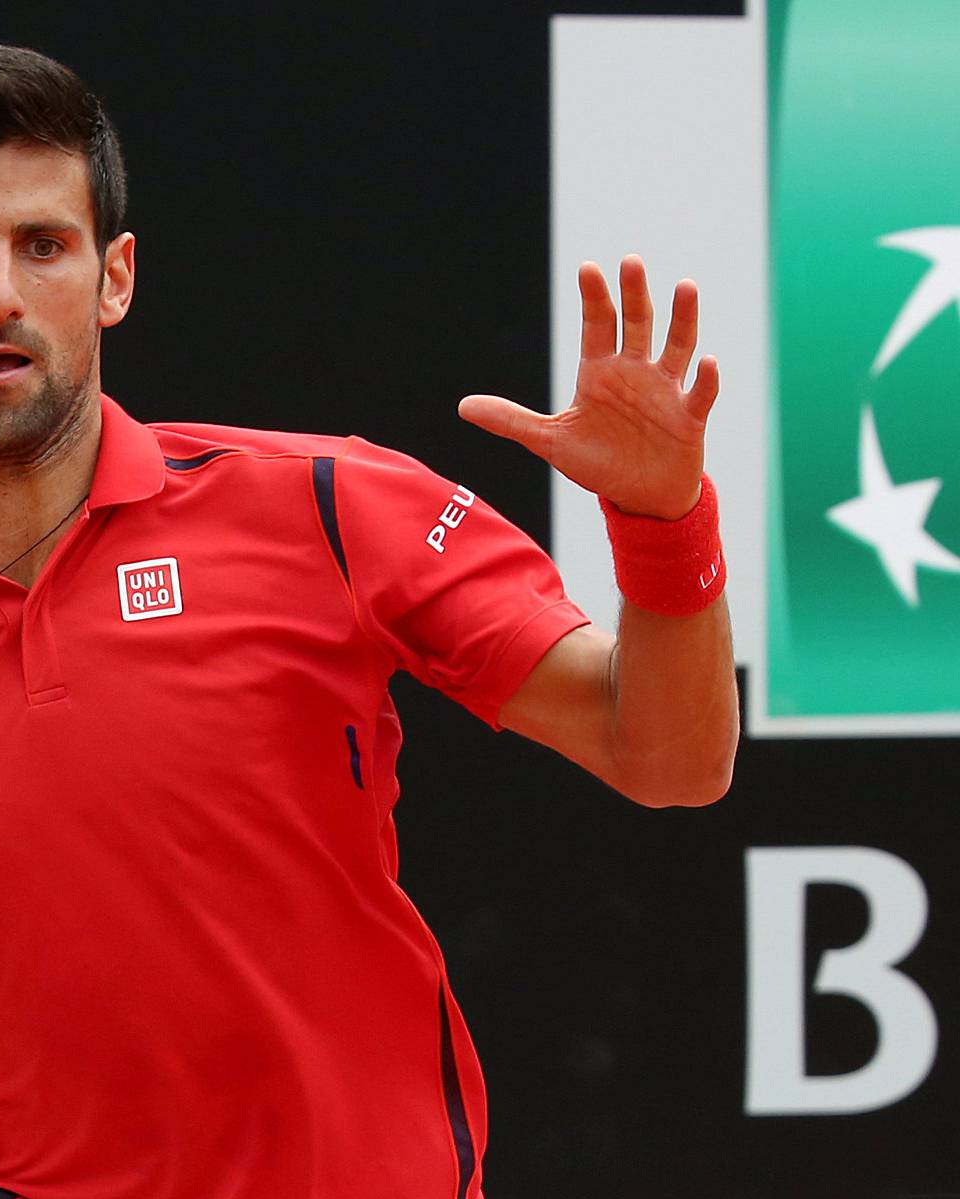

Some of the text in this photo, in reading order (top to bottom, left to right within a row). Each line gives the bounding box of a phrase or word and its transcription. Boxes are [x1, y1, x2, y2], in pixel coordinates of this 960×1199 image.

[425, 484, 476, 554] PEU
[129, 570, 165, 590] UNI
[132, 588, 170, 611] QLO
[745, 845, 938, 1116] B
